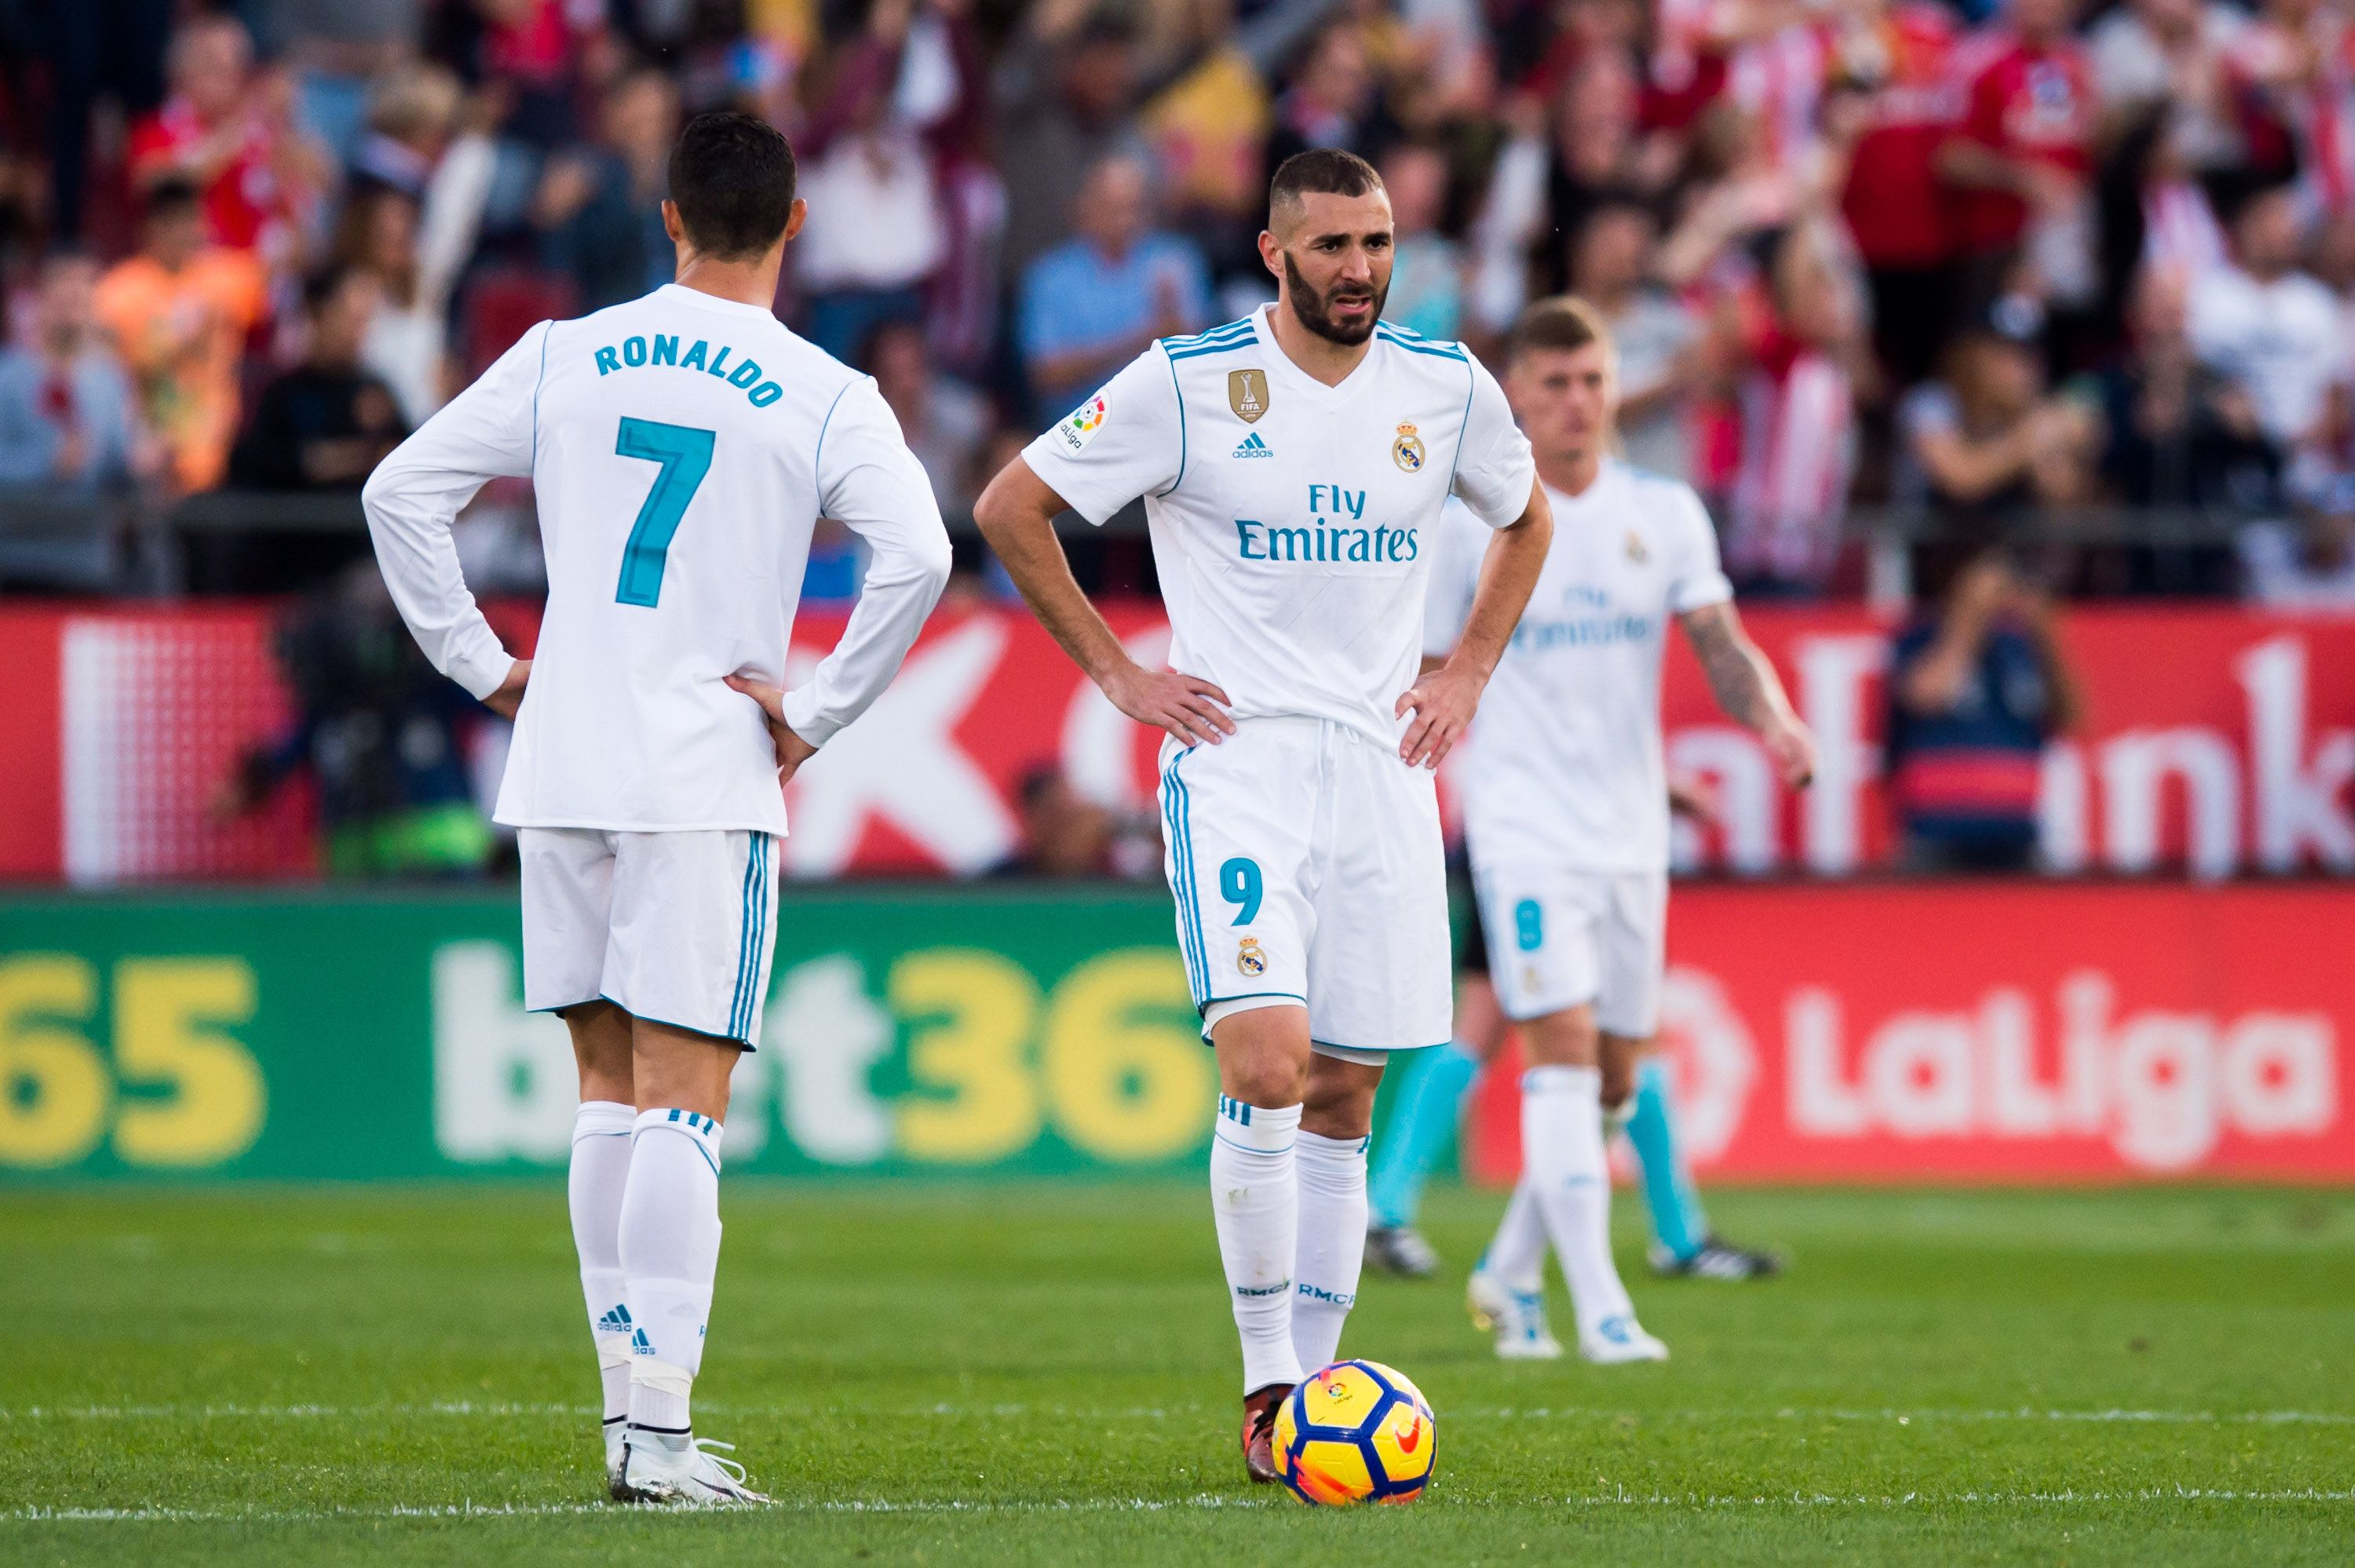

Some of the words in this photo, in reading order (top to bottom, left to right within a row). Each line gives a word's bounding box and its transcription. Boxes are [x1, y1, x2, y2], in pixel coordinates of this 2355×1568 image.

[594, 334, 783, 408] RONALDO
[1240, 403, 1260, 411] FIFA
[1060, 423, 1082, 449] aLiga
[1232, 449, 1274, 458] adidas
[615, 416, 717, 608] 7
[1309, 484, 1366, 520] Fly
[1235, 517, 1418, 562] Emirates
[1220, 857, 1263, 927] 9
[1515, 899, 1542, 951] 8
[1784, 972, 2336, 1173] LaLiga
[597, 1322, 632, 1332] adida
